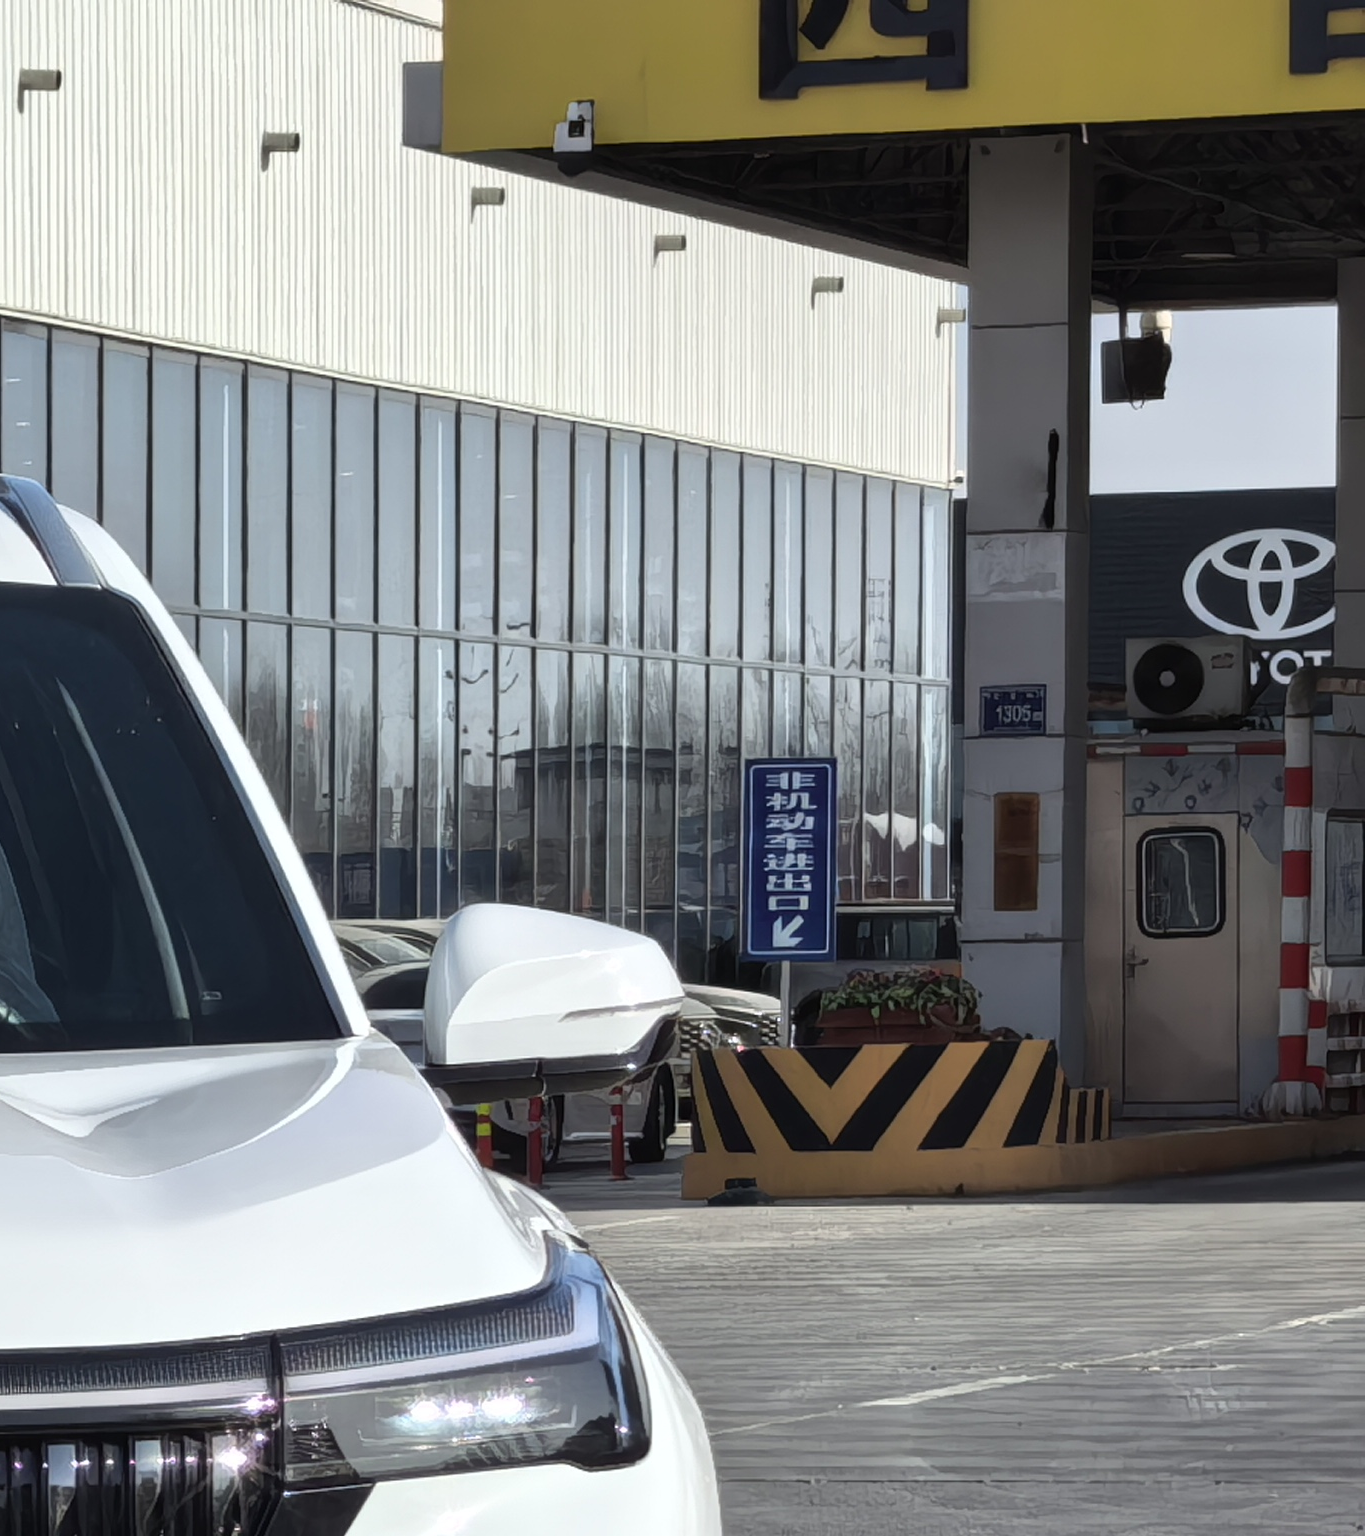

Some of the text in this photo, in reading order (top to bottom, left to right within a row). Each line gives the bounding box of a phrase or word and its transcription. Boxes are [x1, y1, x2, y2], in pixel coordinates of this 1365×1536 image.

[763, 771, 818, 912] 非机动车进出口
